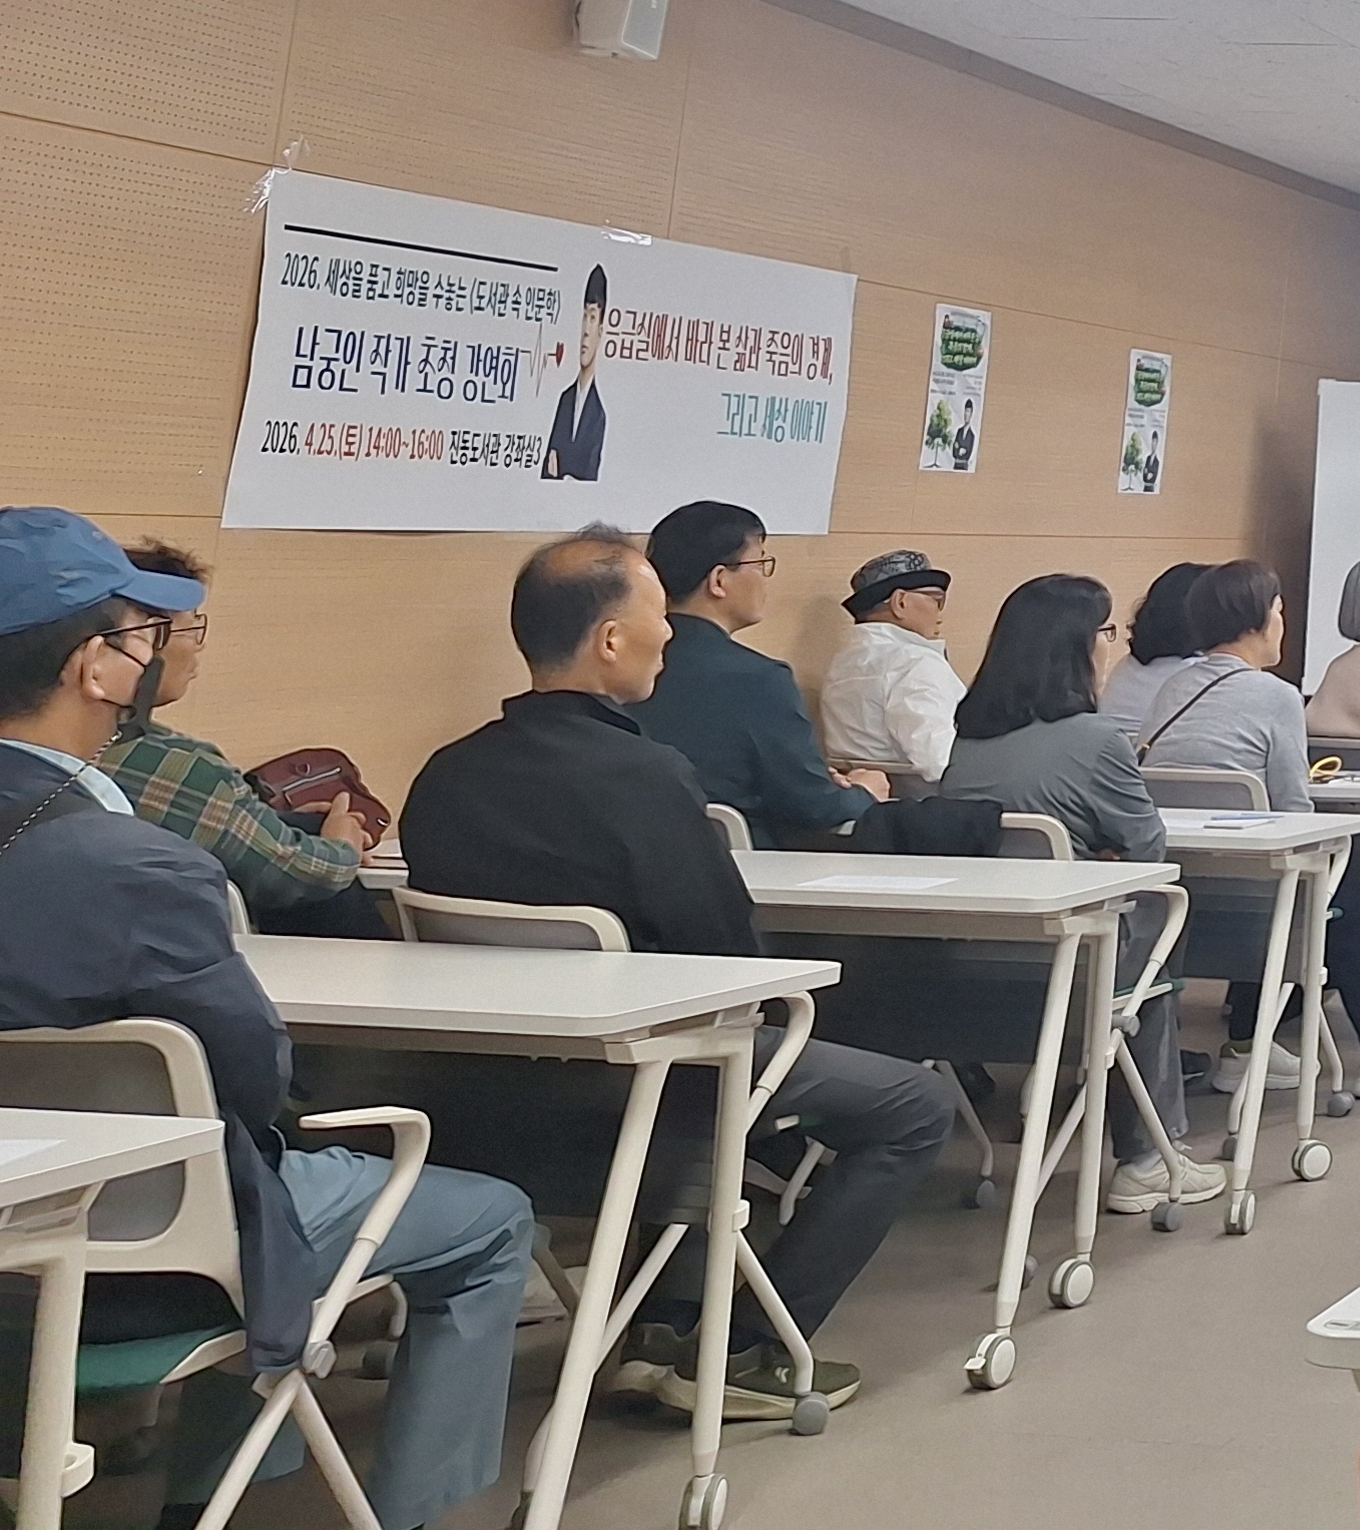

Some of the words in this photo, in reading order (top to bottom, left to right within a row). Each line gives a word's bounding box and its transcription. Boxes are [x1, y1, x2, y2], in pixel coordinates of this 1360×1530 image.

[280, 252, 320, 291] 2026.
[324, 258, 364, 299] 세상을
[365, 263, 392, 301] 품고
[393, 267, 431, 307] 희망을
[432, 273, 468, 312] 수놓는
[469, 277, 510, 318] (도서관
[511, 283, 522, 320] 속
[524, 286, 562, 325] 인문학)
[291, 325, 365, 393] 남궁인
[369, 333, 411, 395] 작가
[415, 335, 458, 400] 초청
[463, 344, 521, 403] 강연회
[604, 307, 684, 363] 응급실에서
[733, 325, 763, 372] 삶과
[765, 329, 804, 377] 죽음의
[806, 335, 833, 386] 경계,
[260, 420, 300, 455] 2026.
[304, 422, 363, 462] 4.25.(토)
[364, 426, 444, 461] 14:00~16:00
[449, 430, 501, 468] 진동도서관
[503, 433, 542, 469] 강좌실3
[716, 392, 759, 438] 그리고
[760, 396, 789, 443] 세상
[790, 398, 828, 444] 이야기
